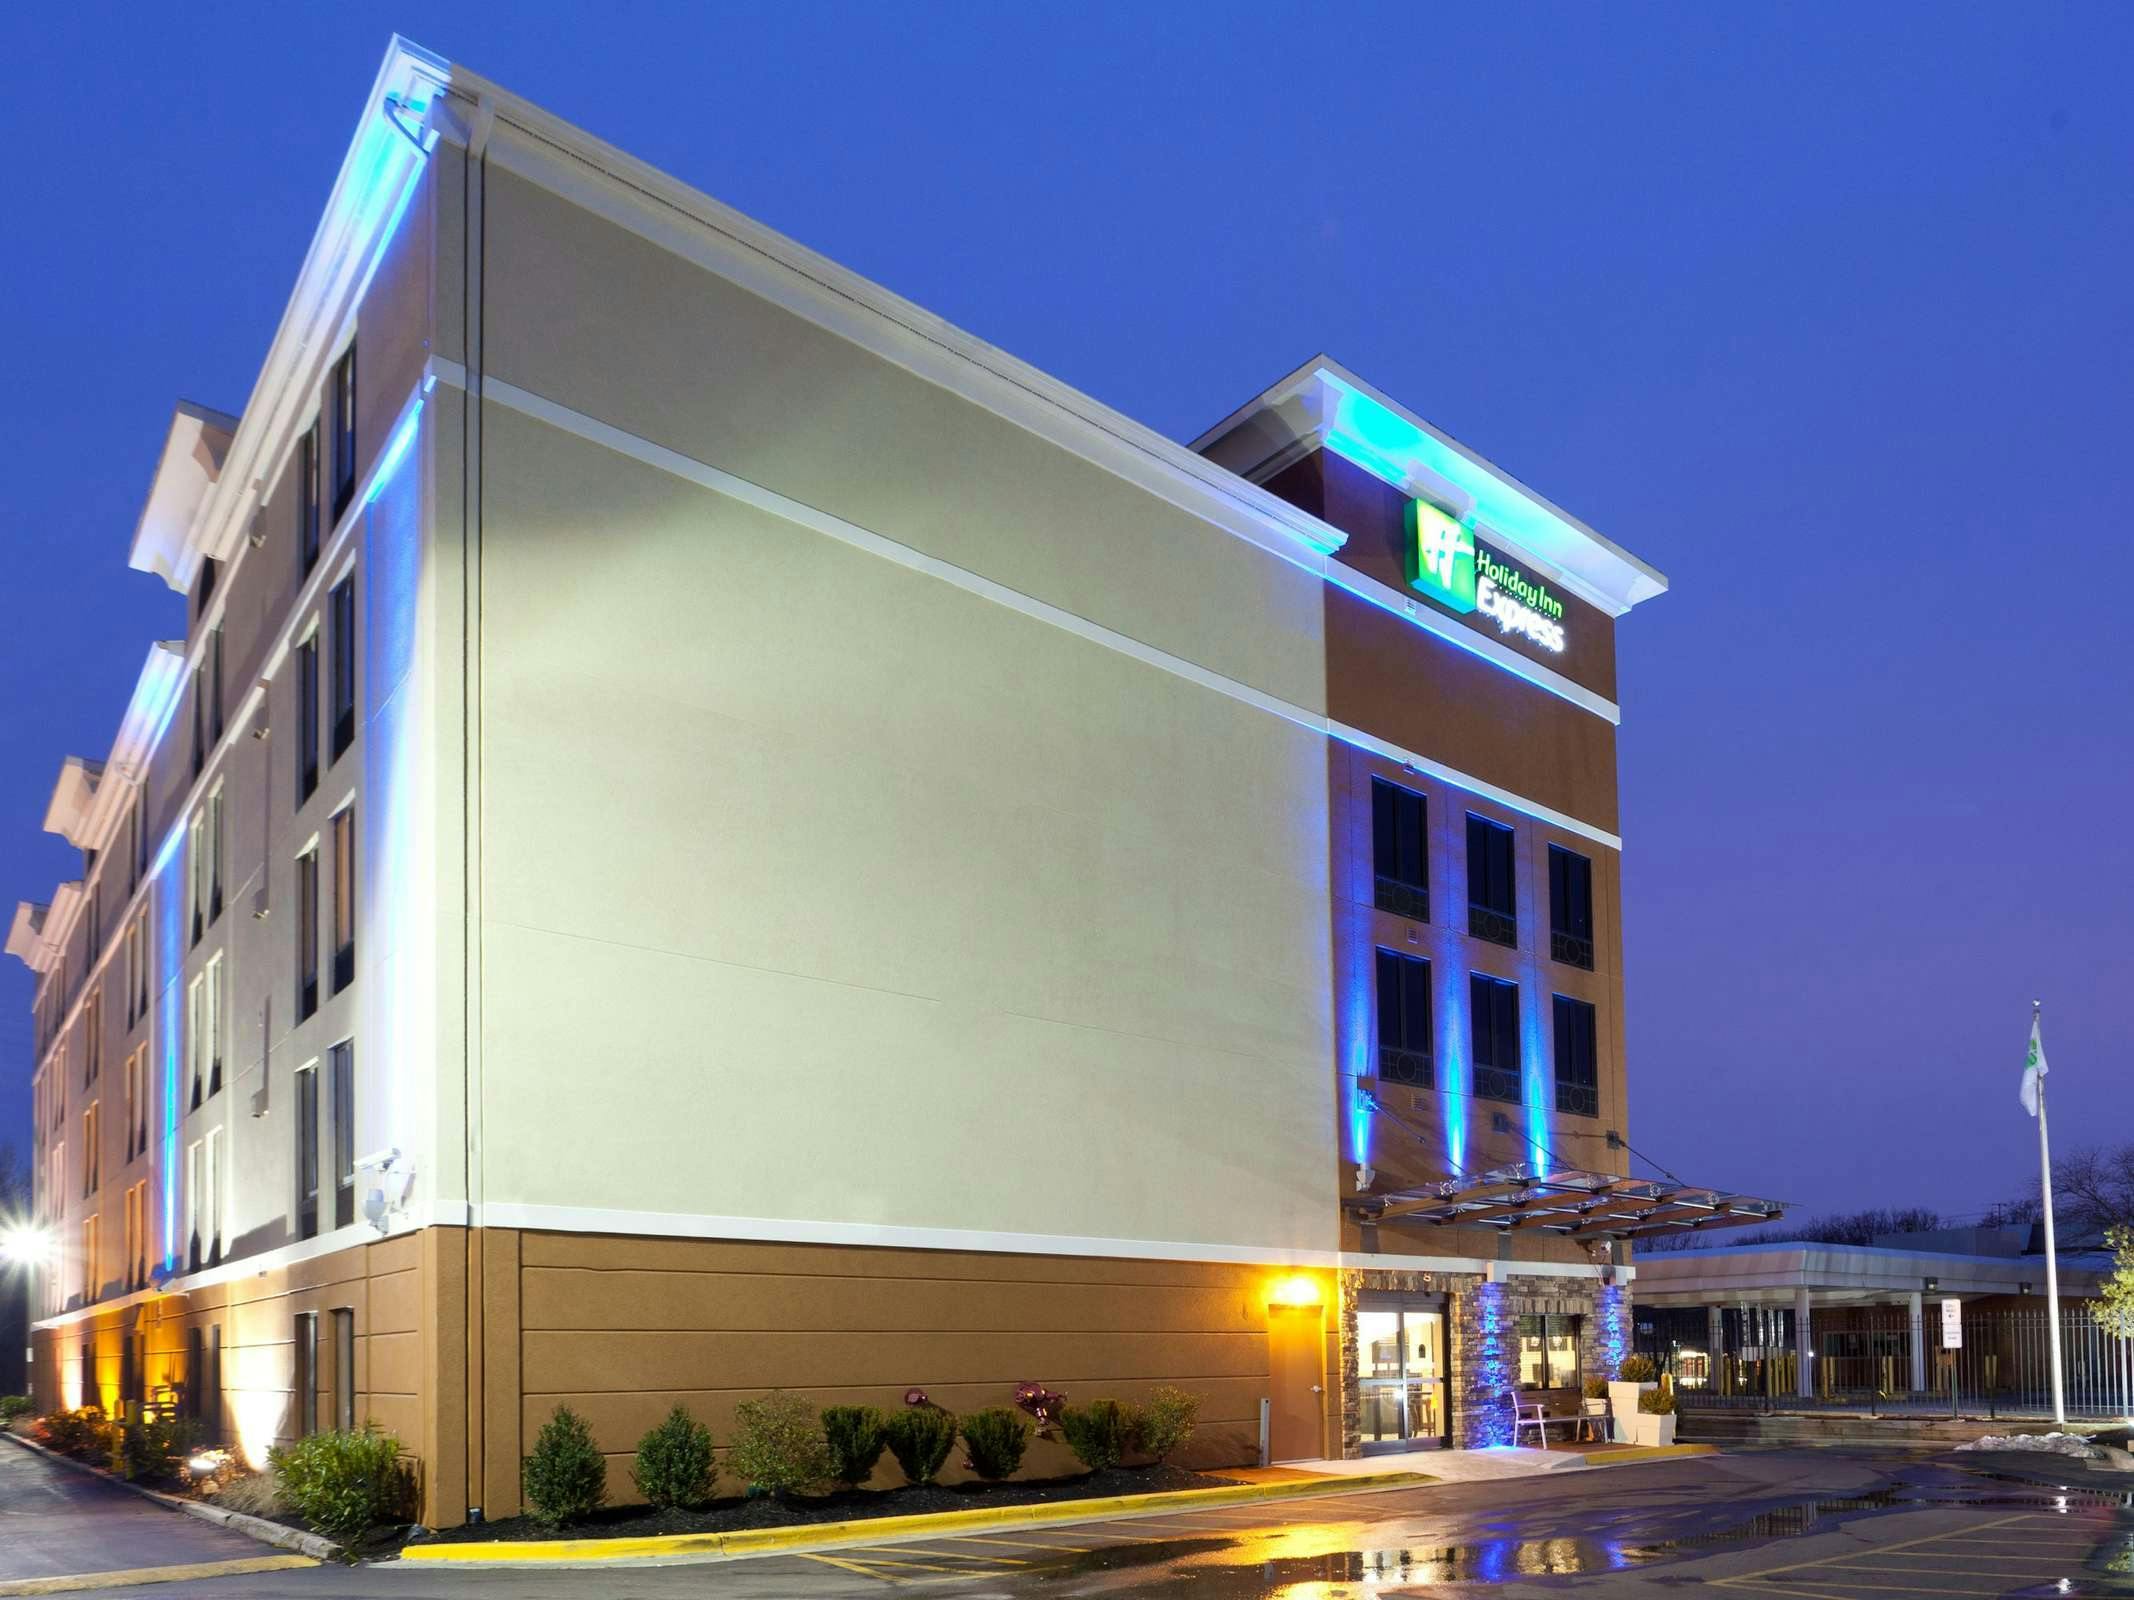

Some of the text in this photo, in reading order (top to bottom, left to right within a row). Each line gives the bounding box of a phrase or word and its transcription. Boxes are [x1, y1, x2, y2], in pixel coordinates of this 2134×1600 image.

[1477, 550, 1562, 618] Holiday Inn
[1477, 575, 1565, 652] Express
